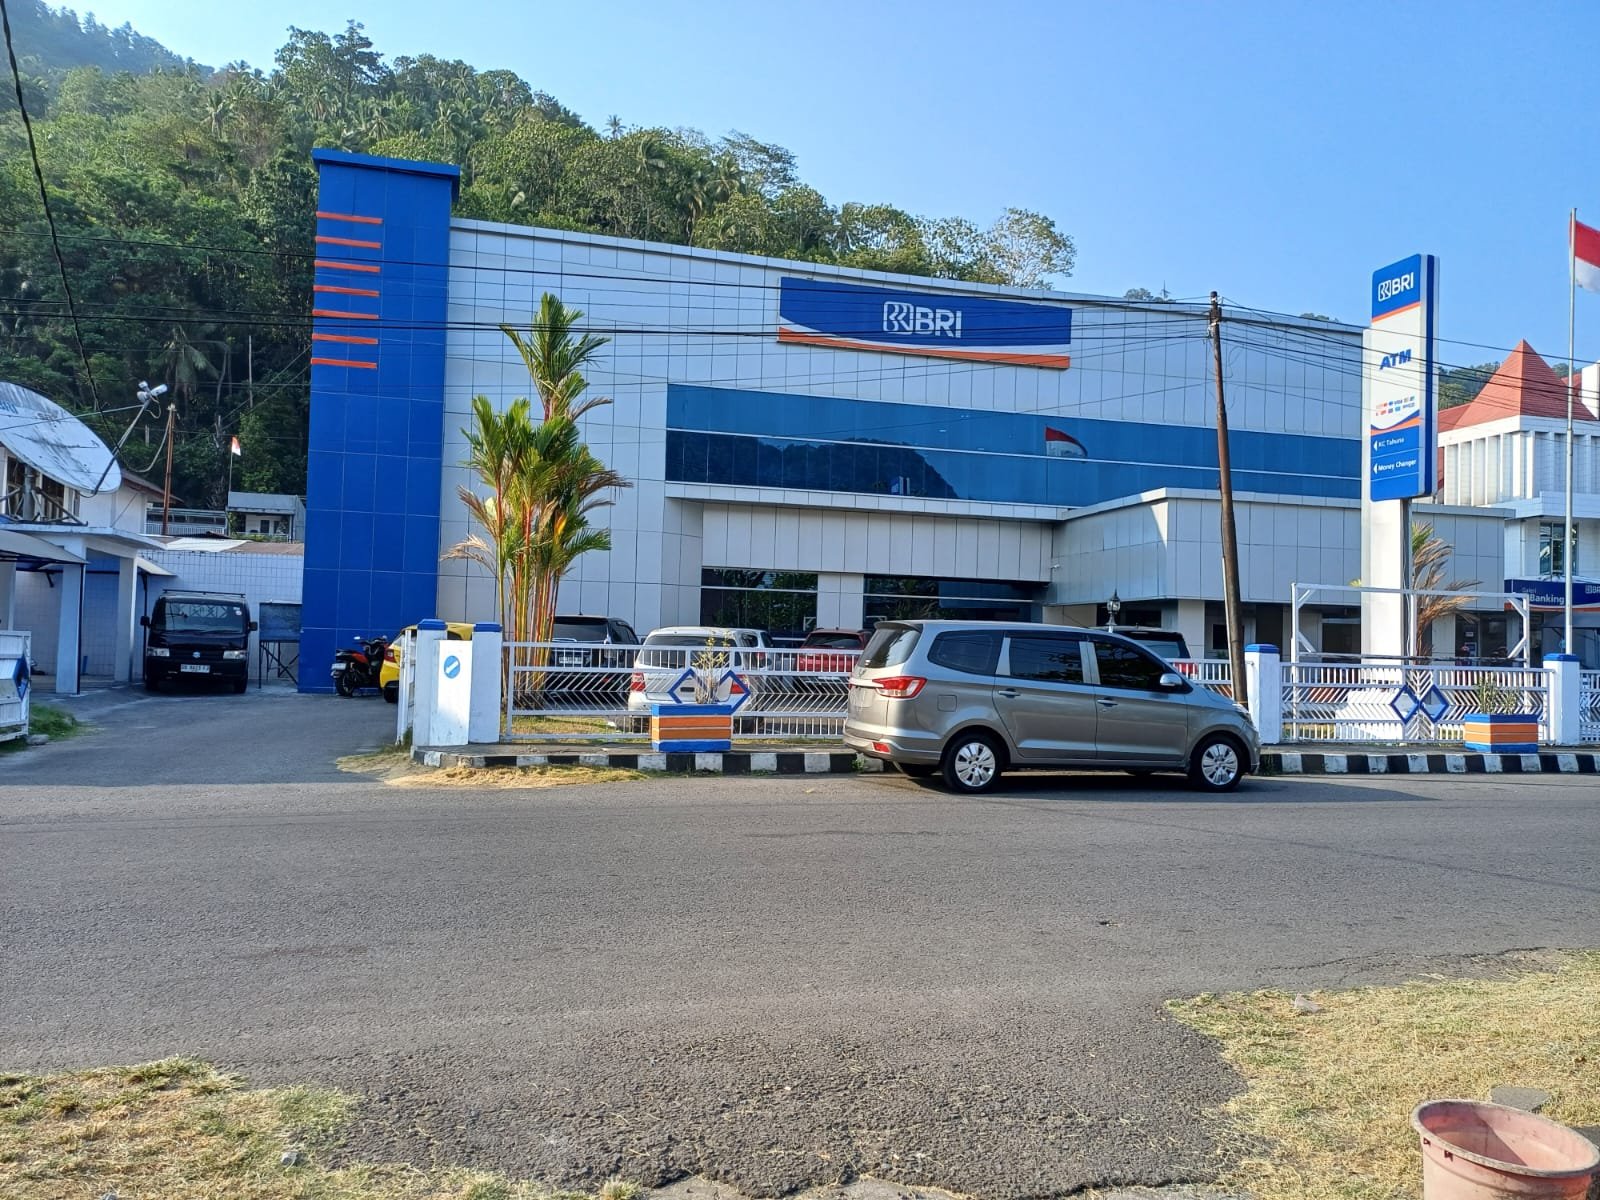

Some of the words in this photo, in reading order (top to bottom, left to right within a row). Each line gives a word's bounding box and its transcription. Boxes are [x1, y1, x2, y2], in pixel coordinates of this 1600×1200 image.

[1392, 272, 1414, 296] BRI
[915, 306, 962, 338] BRI
[1379, 348, 1411, 371] ATM
[1378, 463, 1394, 472] Money
[1530, 593, 1564, 605] Banking
